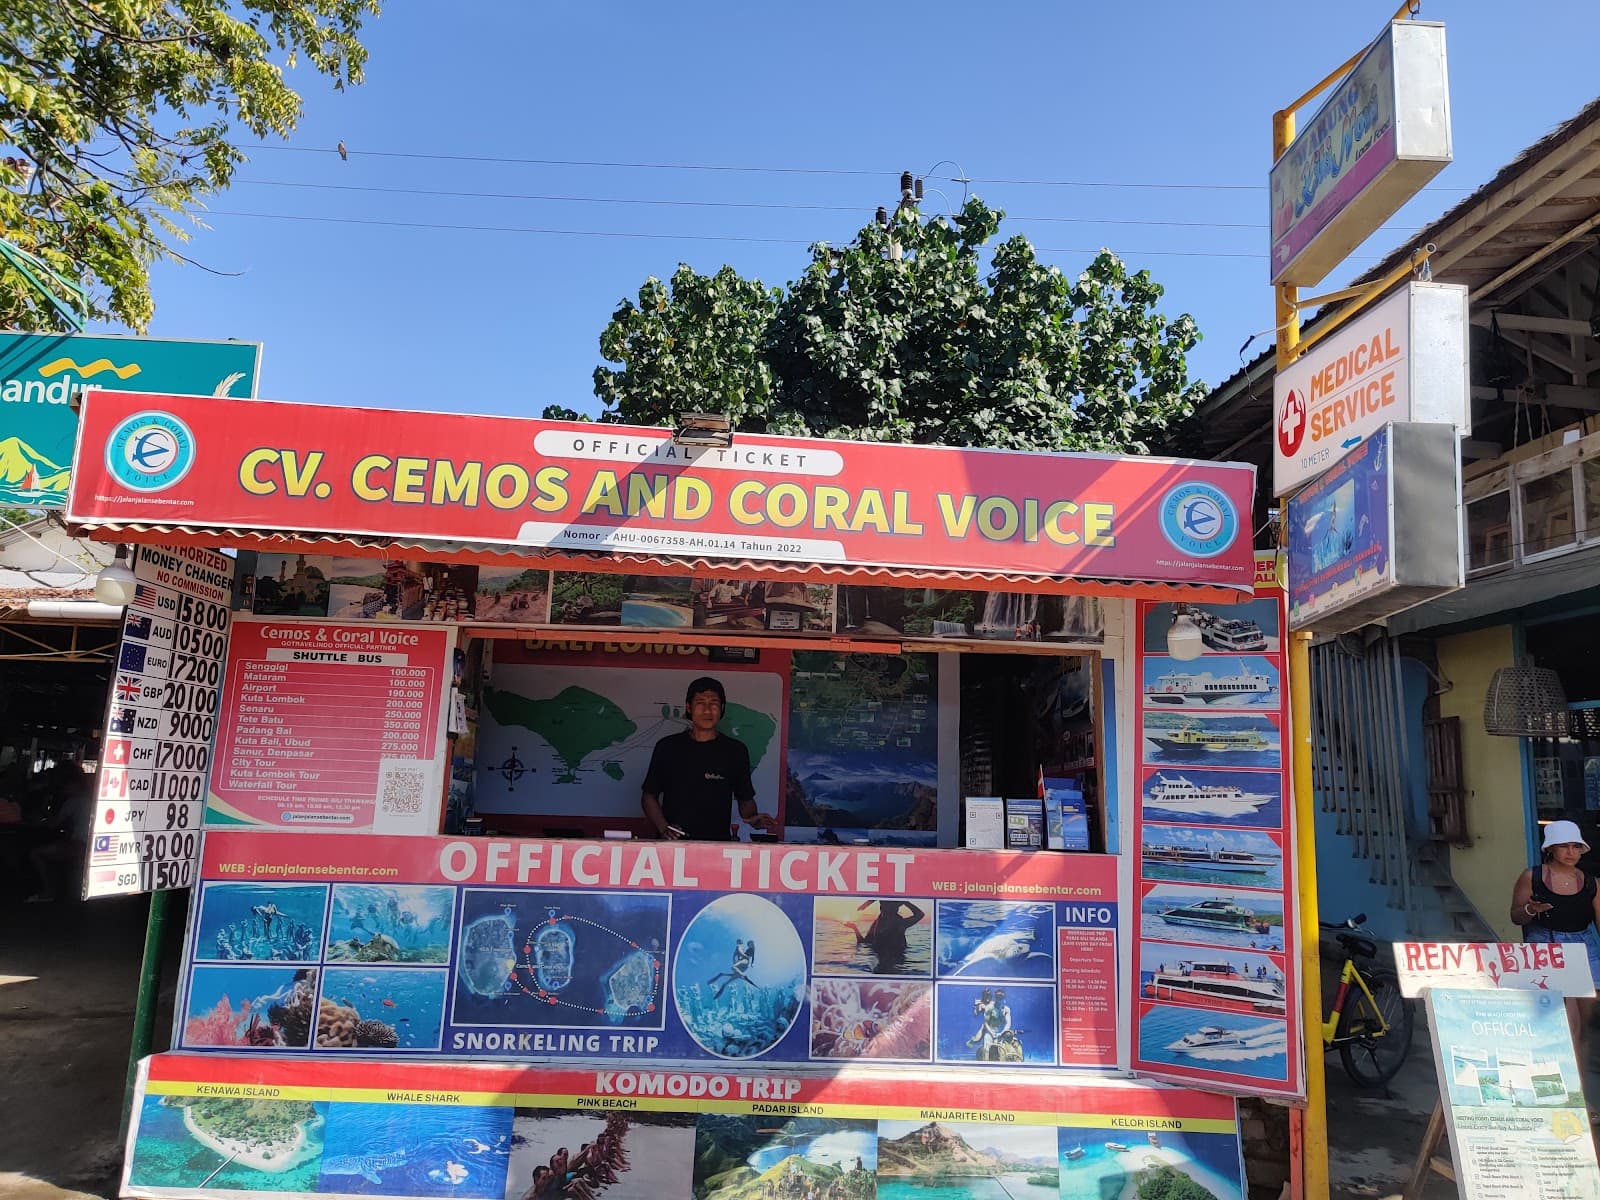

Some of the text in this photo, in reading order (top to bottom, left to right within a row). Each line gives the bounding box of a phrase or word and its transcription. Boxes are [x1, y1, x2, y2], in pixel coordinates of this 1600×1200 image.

[1310, 327, 1400, 403] MEDICAL
[1311, 371, 1396, 442] SERVICE
[573, 438, 807, 468] OFFICIAL TICKET
[1308, 448, 1330, 467] METER
[238, 447, 1116, 549] CV. CEMOS AND CORAL VOICE
[563, 529, 601, 541] Nomor
[613, 532, 736, 550] AHU-0067358-AH.01.14
[740, 540, 773, 552] Tahun
[777, 542, 802, 553] 2022
[155, 544, 228, 572] UTHORIZED
[141, 546, 233, 591] MONEY CHANGER
[157, 570, 224, 601] NO COMMISSION
[157, 593, 228, 632] USD 15800
[152, 623, 224, 660] AUD 10500
[260, 626, 419, 646] Cemos & Coral Voice
[281, 640, 333, 649] GOTRAVELINDO
[293, 651, 382, 663] SHUTTLE BUS
[147, 652, 219, 687] EURO 17200
[245, 662, 426, 677] Senggigi 100.000
[244, 672, 425, 688] Mataram 100.000
[143, 682, 217, 714] GBP 20100
[242, 683, 424, 698] Airport 190.000
[241, 694, 423, 709] Kuta Lombok 200.000
[238, 714, 258, 722] Tete
[261, 715, 284, 724] Batu
[240, 704, 422, 719] Senaru 250.000
[137, 713, 213, 742] NZD 9000
[236, 725, 273, 735] Padang
[276, 727, 292, 735] Bai
[235, 737, 258, 745] Kuta
[284, 738, 311, 747] Ubud
[133, 741, 208, 771] CHF 17000
[267, 748, 314, 758] Denpasar
[232, 758, 276, 768] City Tour
[230, 769, 320, 780] Kuta Lombok Tour
[129, 772, 201, 801] CAD 11000
[229, 780, 297, 790] Waterfall Tour
[124, 802, 189, 830] JPY 98
[119, 841, 141, 854] MYR
[219, 863, 244, 873] WEB
[252, 863, 398, 877] jalanjalansebentar.com
[439, 841, 914, 893] OFFICIAL TICKET
[117, 873, 137, 887] SGD
[932, 881, 957, 891] WEB
[963, 881, 1101, 896] jalanjalansebentar.com
[1065, 907, 1111, 924] INFO
[1404, 942, 1489, 972] RENT
[1472, 1020, 1537, 1037] OFFICIAL
[453, 1032, 659, 1053] SNORKELING TRIP
[196, 1084, 281, 1098] KENAWA ISLAND
[595, 1071, 802, 1100] KOMODO TRIP
[387, 1092, 461, 1104] WHALE SHARK
[577, 1098, 637, 1108] PINK BEACH
[752, 1104, 824, 1115] PADAR ISLAND
[920, 1110, 1015, 1123] MANJARITE ISLAND
[1111, 1118, 1182, 1130] KELOR ISLAND
